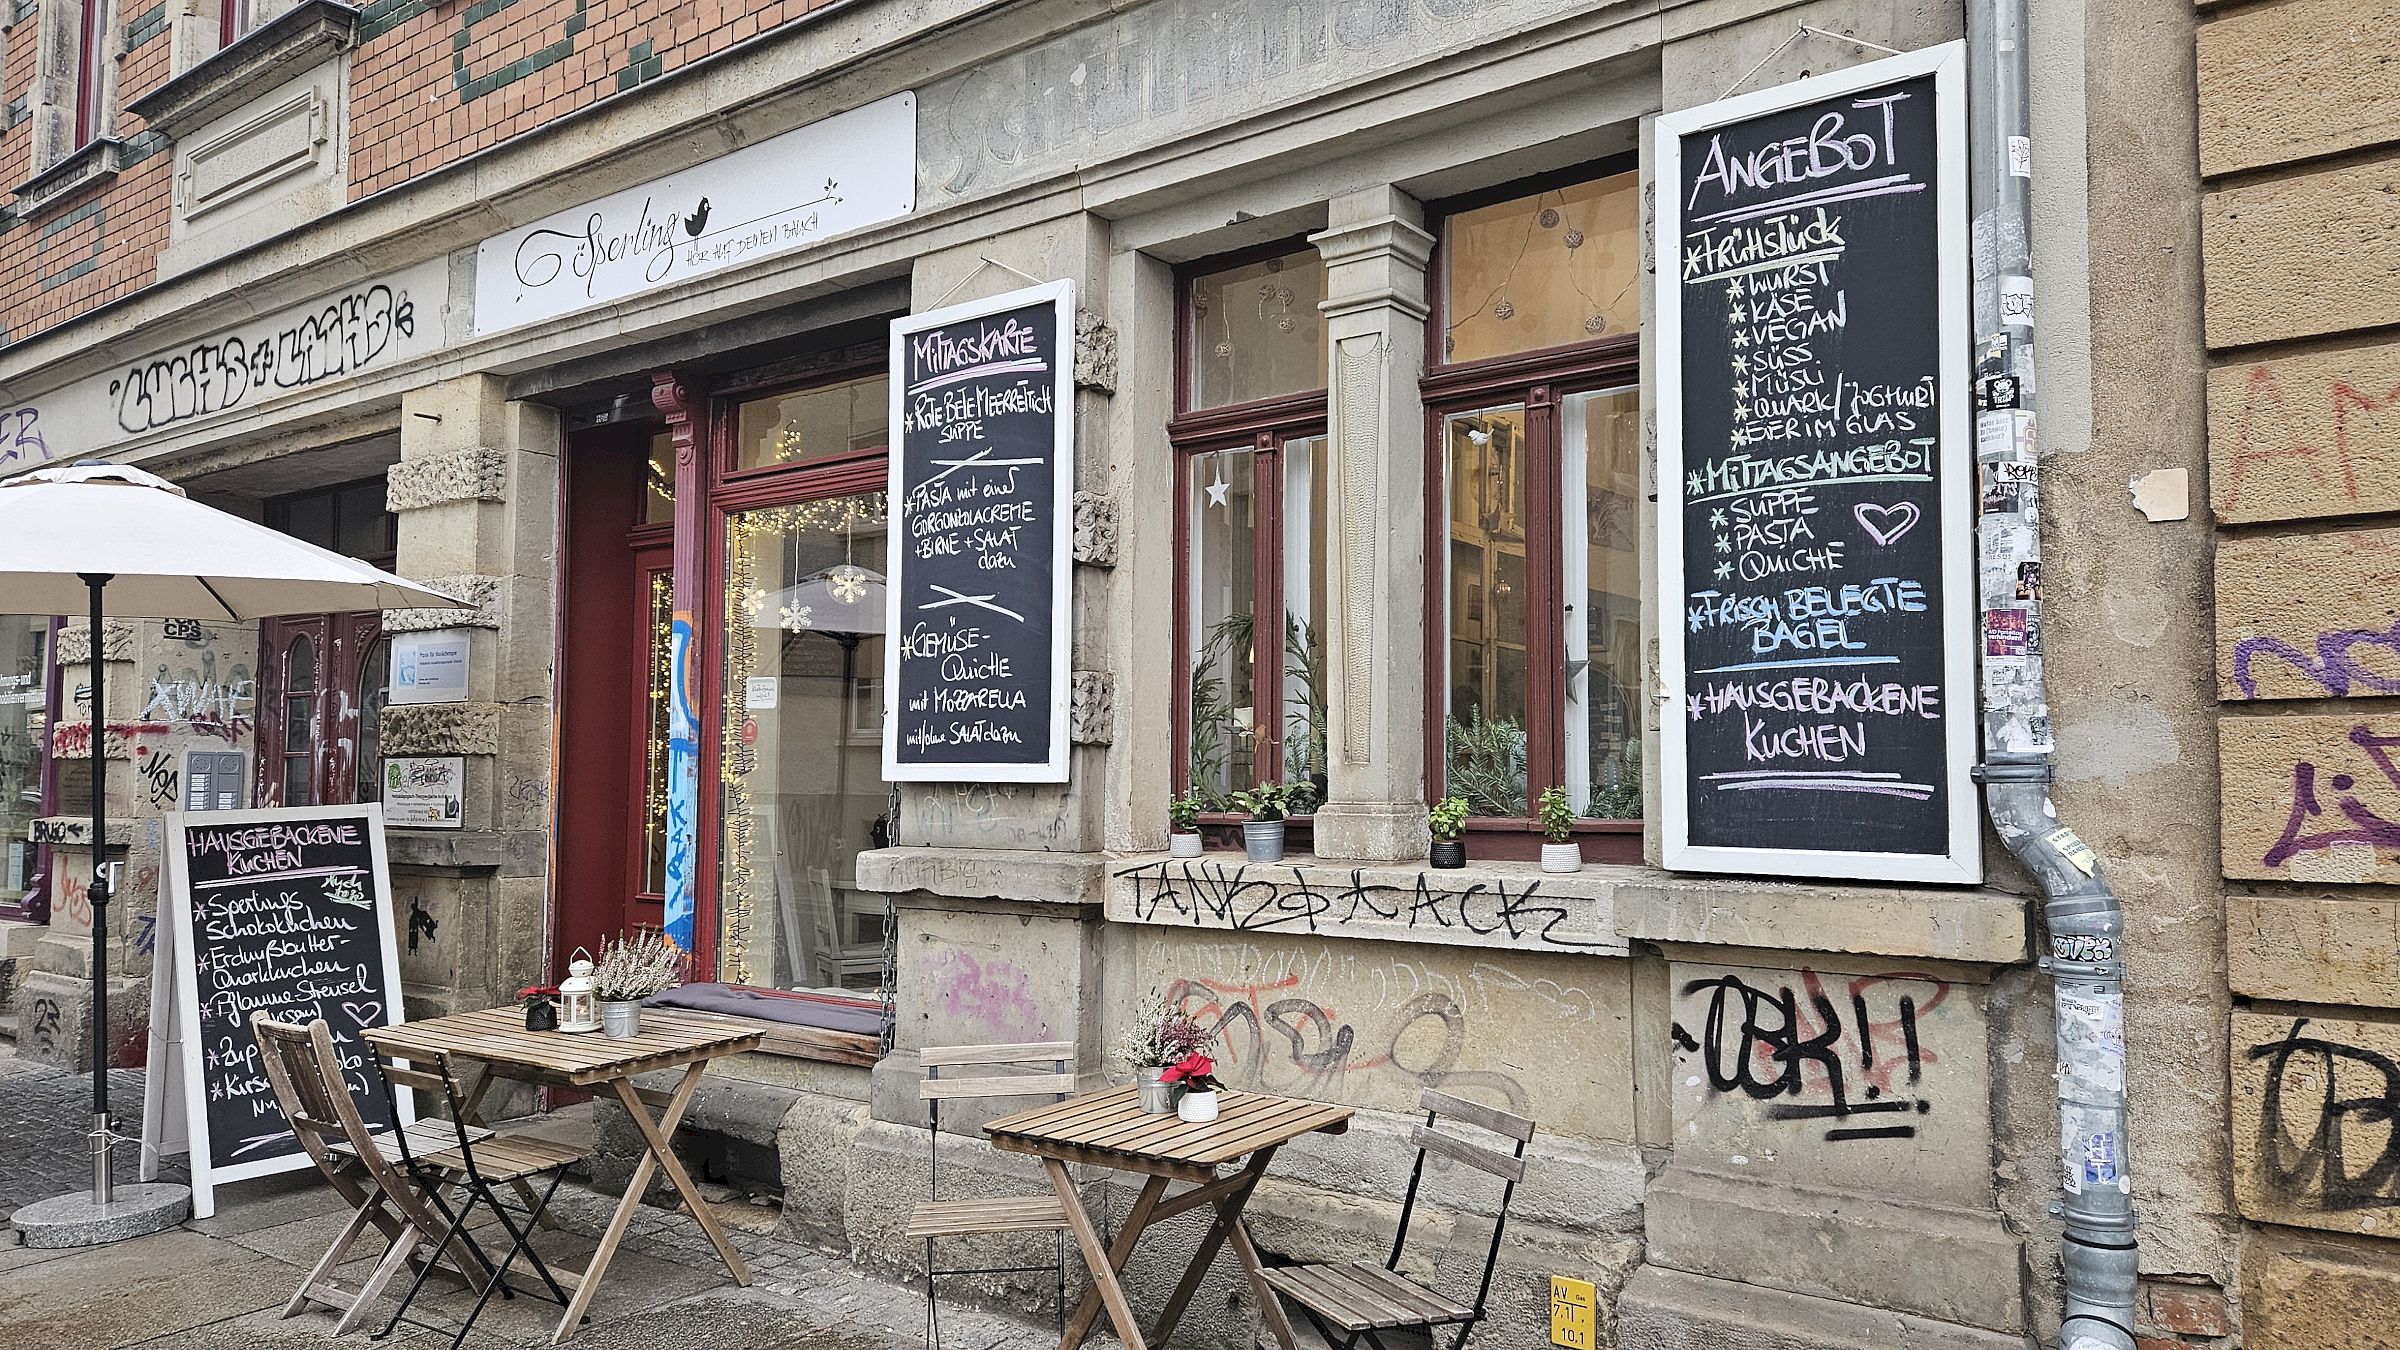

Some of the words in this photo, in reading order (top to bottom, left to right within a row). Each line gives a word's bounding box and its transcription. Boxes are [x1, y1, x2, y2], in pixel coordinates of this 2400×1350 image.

[1688, 92, 1911, 211] ANGEBOT
[782, 210, 818, 240] BAUCH
[515, 196, 680, 298] Sperling
[1750, 261, 1829, 296] WURST
[1750, 287, 1814, 323] KÄSE
[1751, 289, 1847, 345] VEGAN
[938, 420, 986, 443] SUPPE
[1846, 411, 1916, 435] GLAS
[912, 481, 952, 513] PASTA
[957, 475, 978, 501] mit
[1730, 487, 1819, 523] SUPPE
[911, 501, 1036, 538] GORGONZOLACREME
[1734, 515, 1815, 550] PASTA
[978, 550, 1017, 570] dazu
[1739, 541, 1845, 581] QUICHE
[1784, 577, 1927, 621] BELEGTE
[1741, 617, 1867, 654] BAGEL
[909, 690, 929, 712] mit
[1704, 673, 1940, 719] HAUSGEBACKENE
[949, 719, 987, 745] SALAT
[984, 721, 1023, 744] dazu
[1744, 711, 1866, 762] KUCHEN
[187, 824, 362, 857] HAUSGEBACKENE
[227, 847, 302, 875] KUCHEN
[206, 905, 358, 941] Schokokuchen
[208, 890, 304, 927] Sperlings
[212, 955, 350, 990] Quarkkuchen
[1575, 1294, 1586, 1302] Gas
[1561, 1327, 1584, 1345] 10,1
